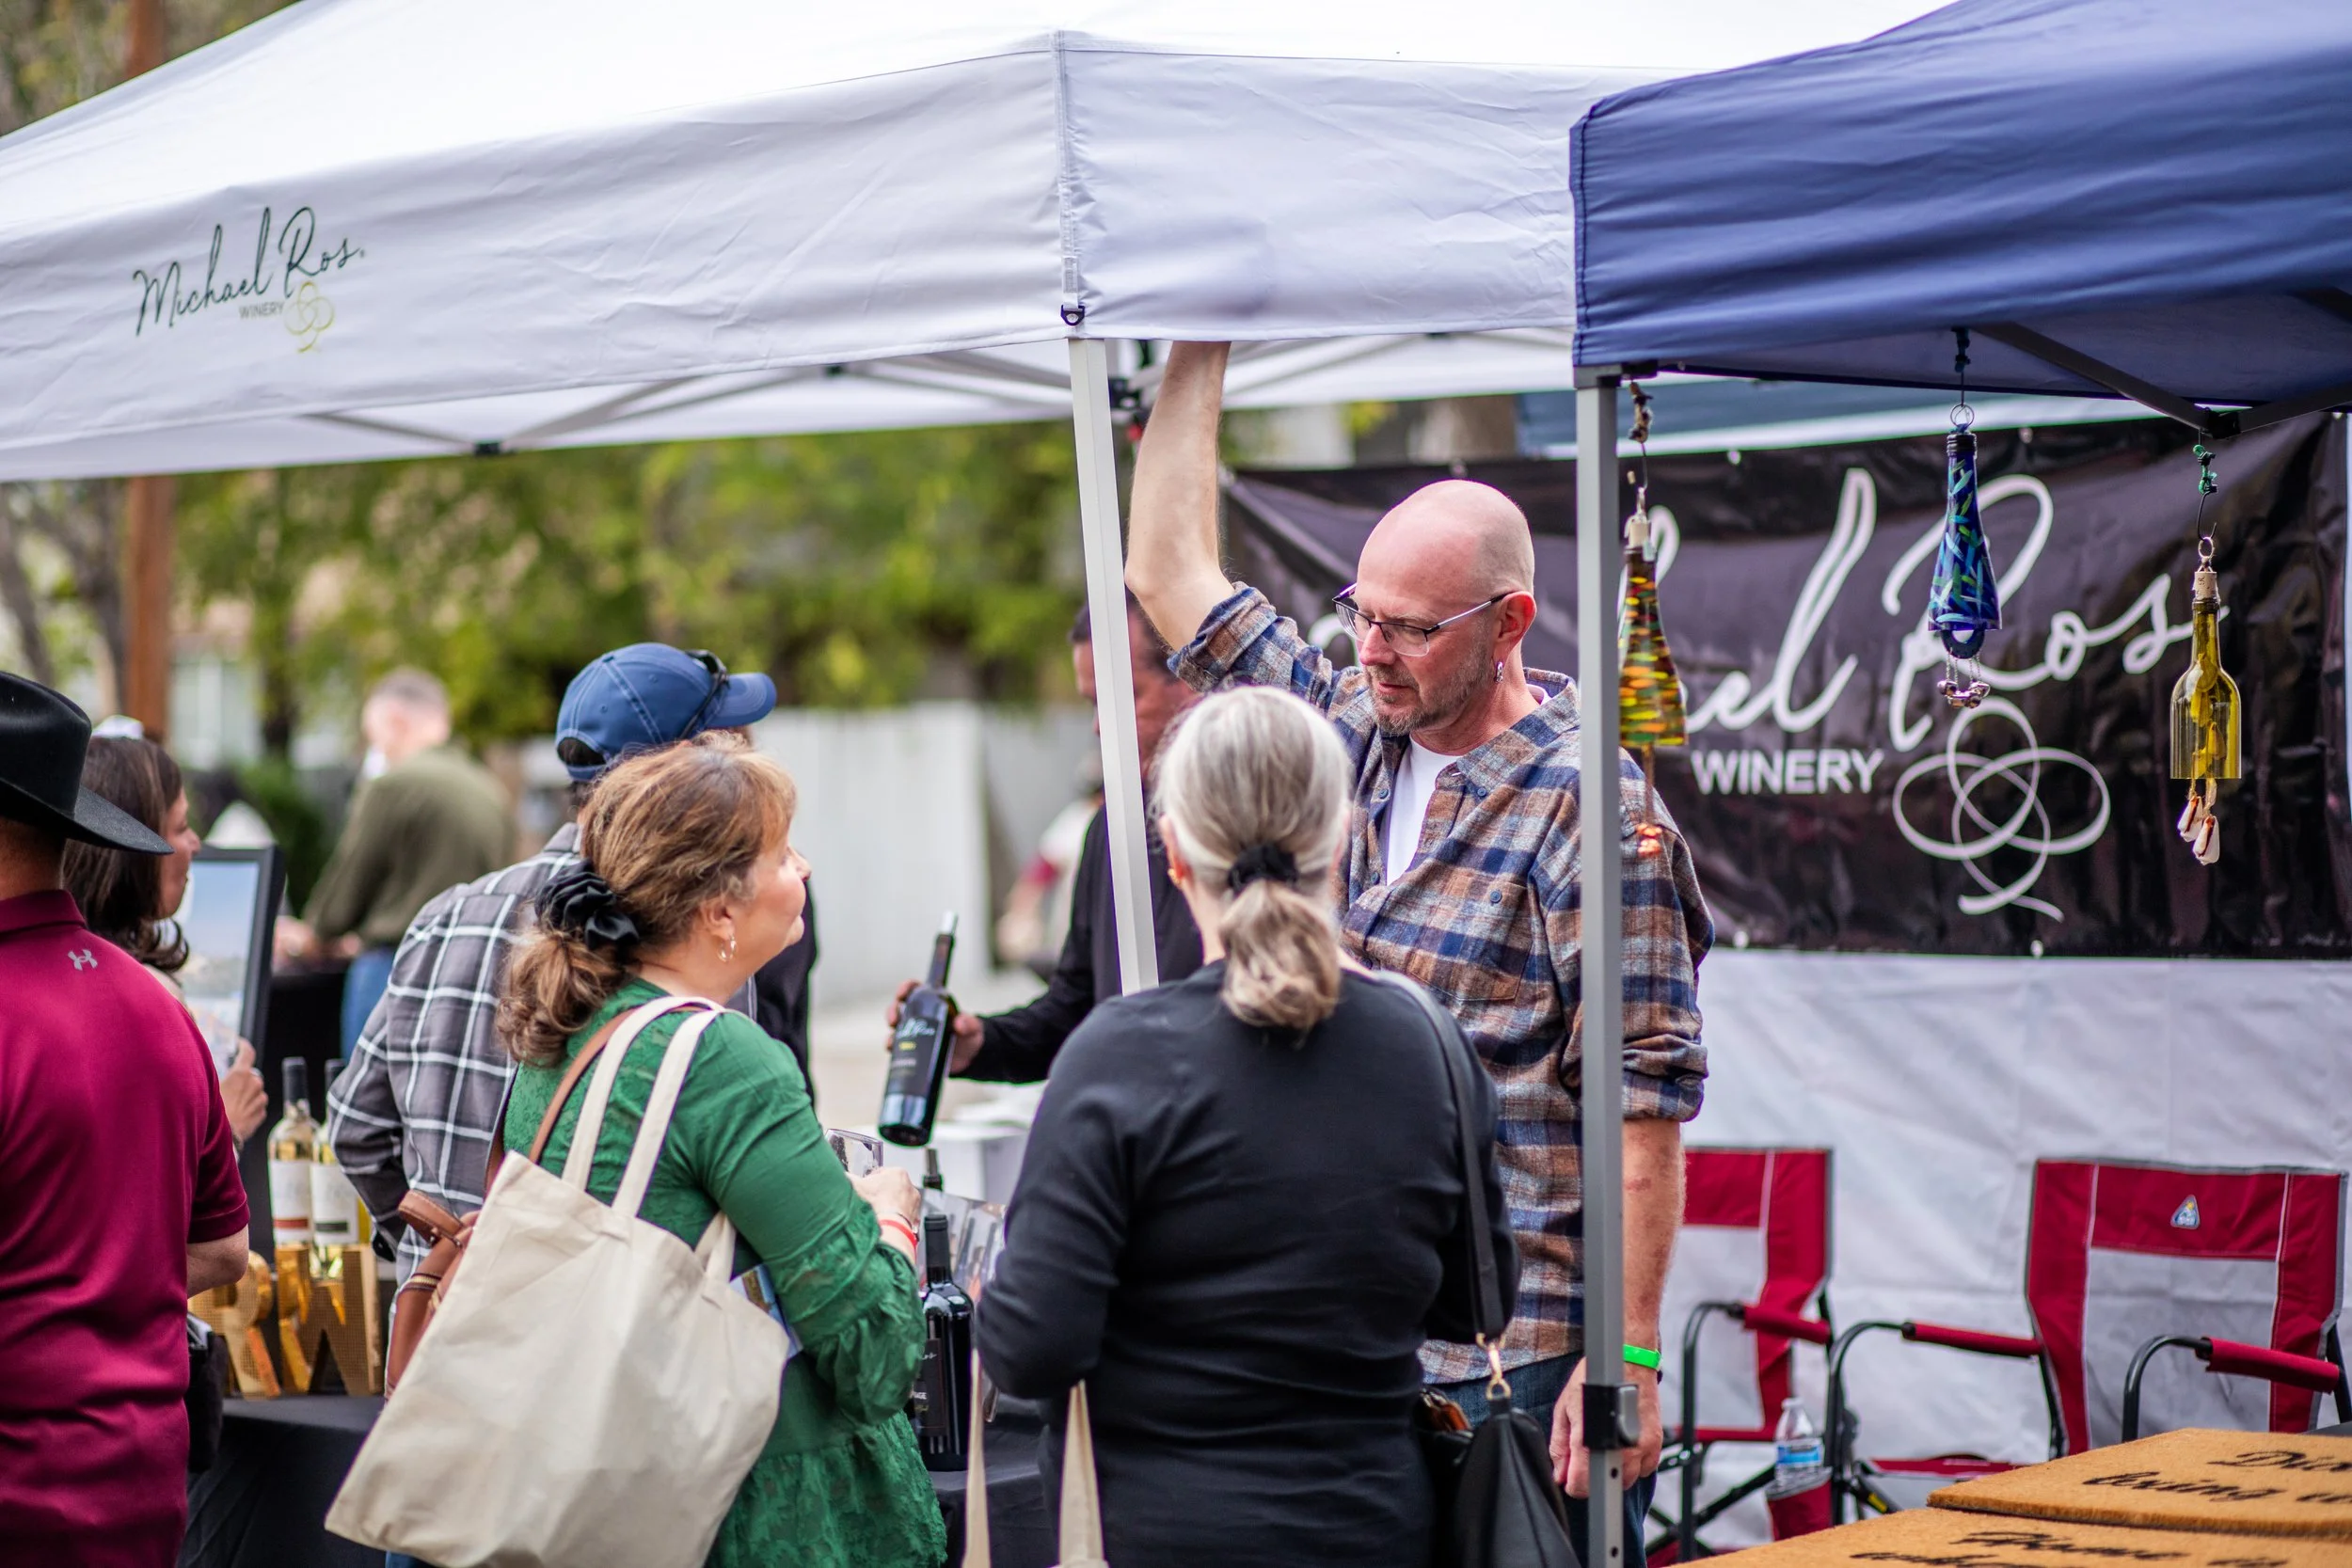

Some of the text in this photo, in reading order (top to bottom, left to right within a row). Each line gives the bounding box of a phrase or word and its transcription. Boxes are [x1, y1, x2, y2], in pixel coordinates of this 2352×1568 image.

[133, 207, 274, 337] Michael
[238, 301, 285, 320] WINERY
[1883, 473, 2231, 752] Ros
[1691, 749, 1884, 795] WINERY
